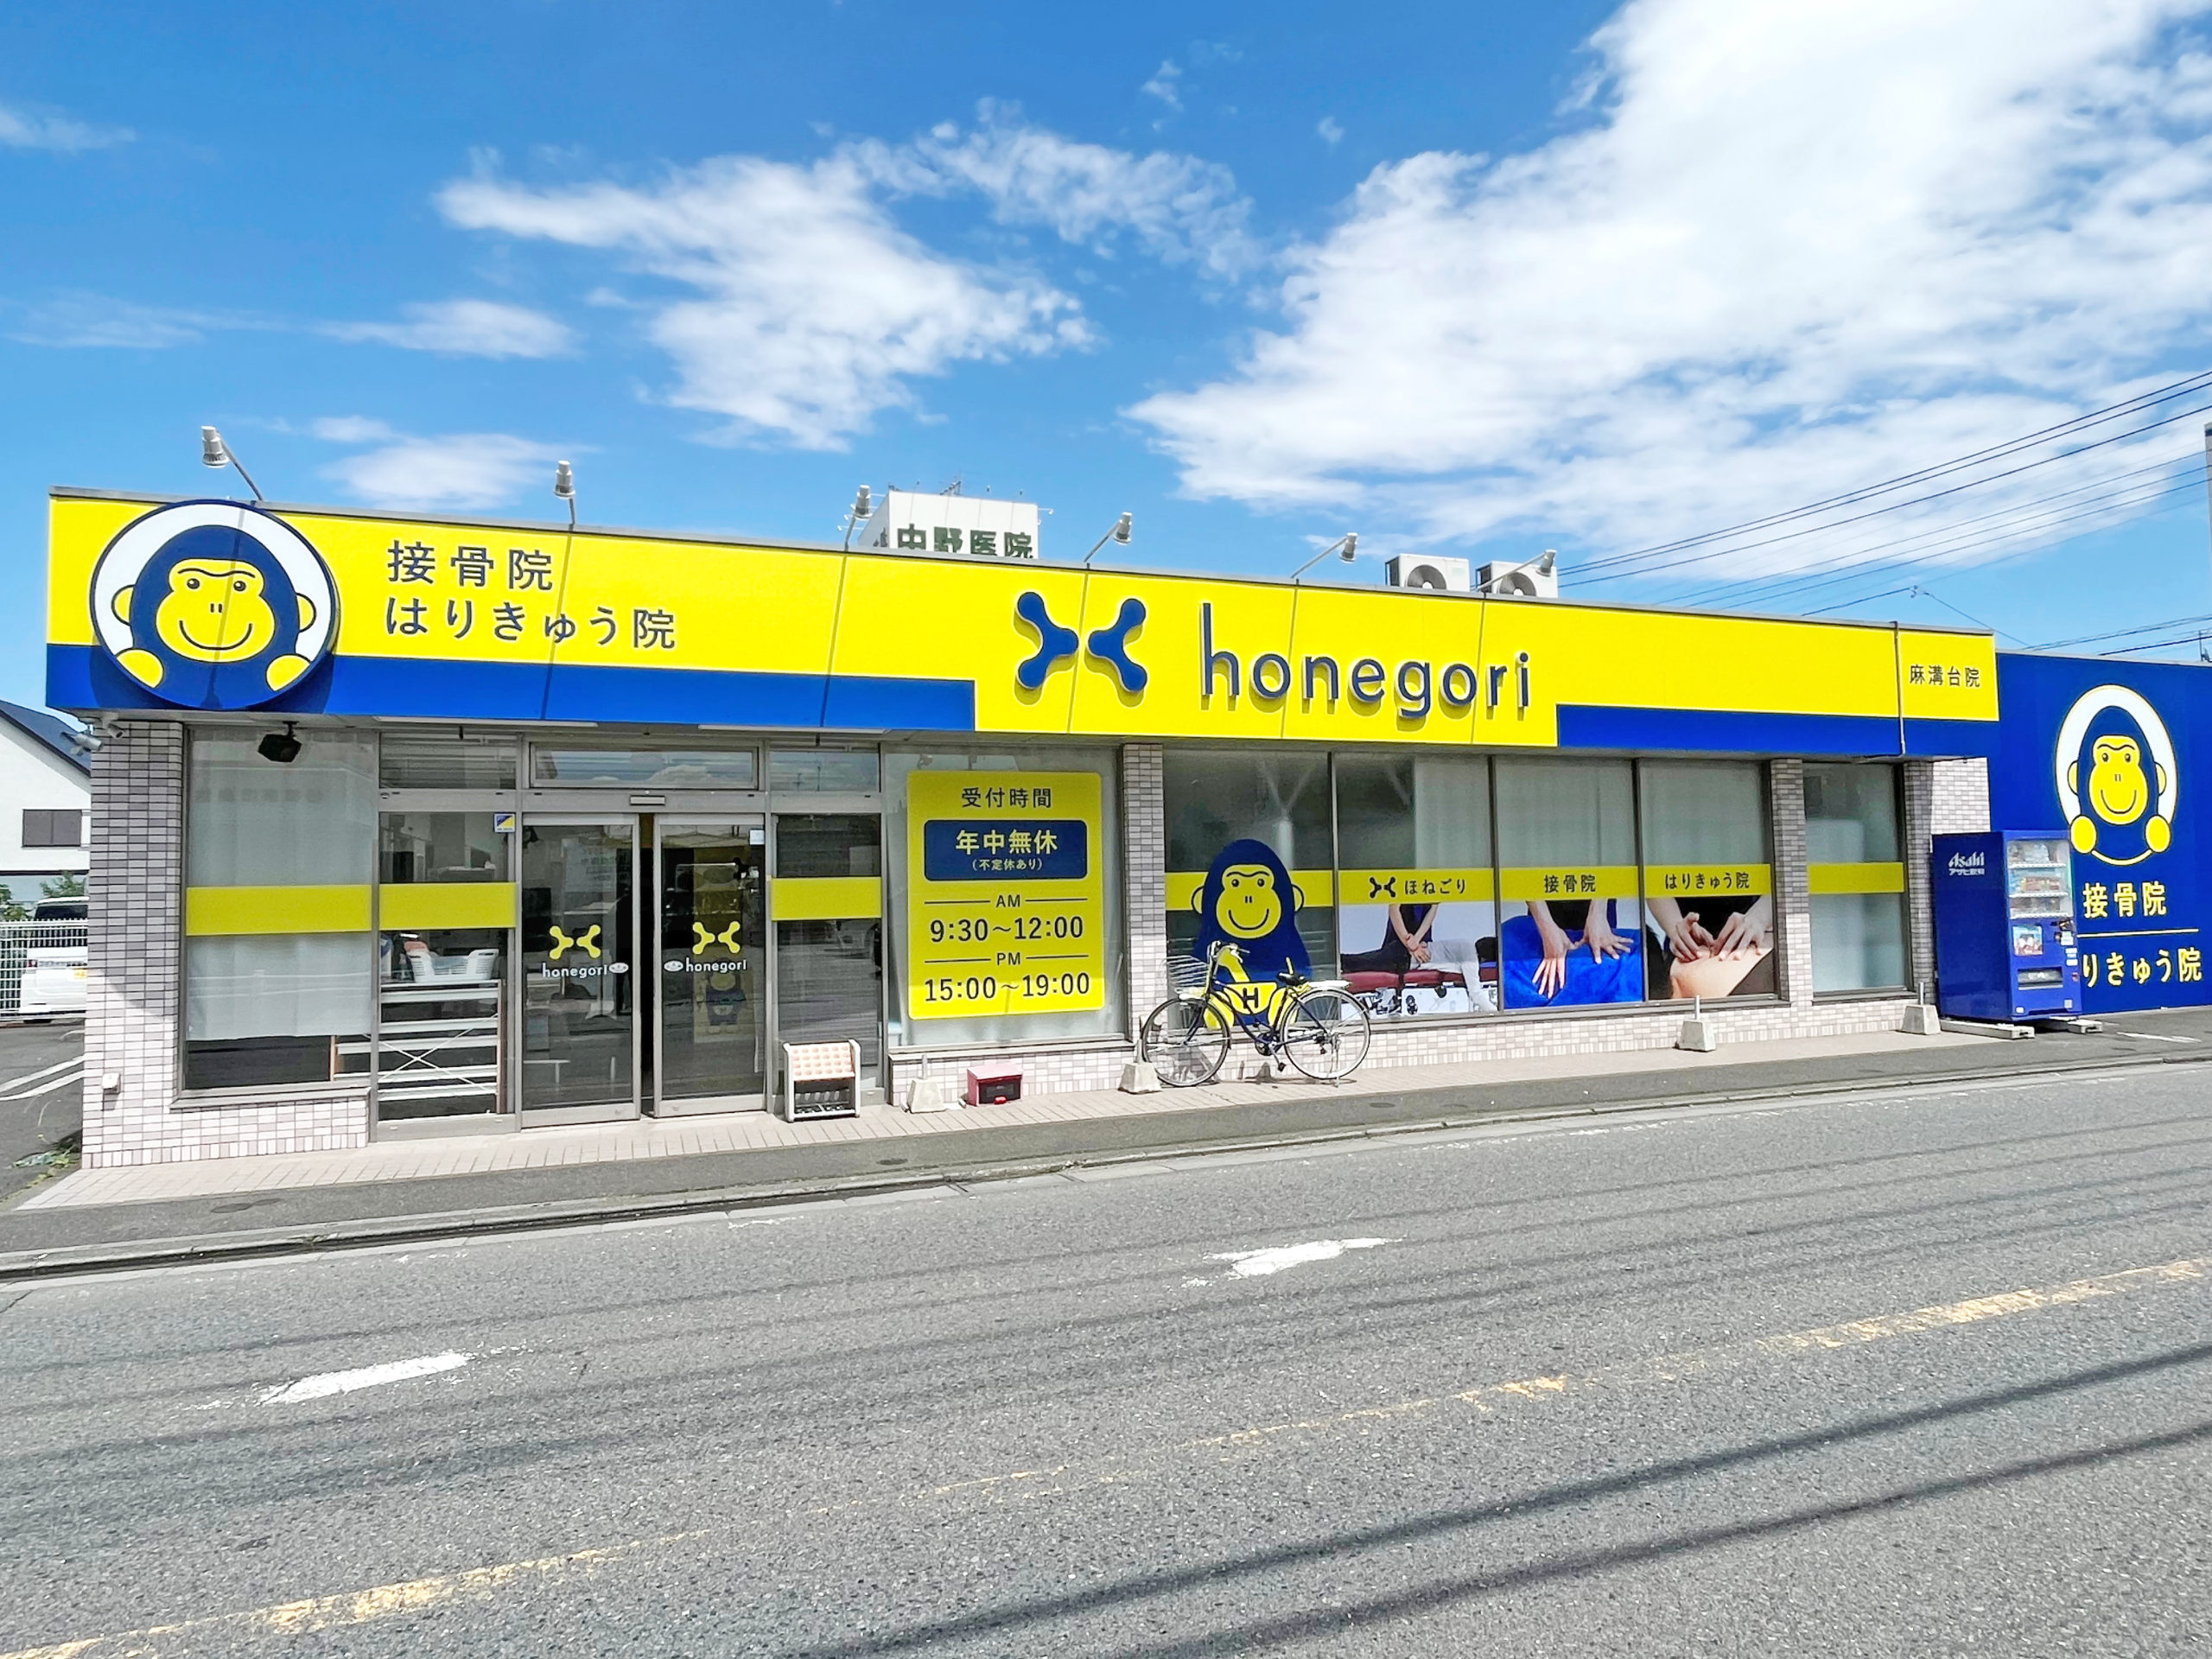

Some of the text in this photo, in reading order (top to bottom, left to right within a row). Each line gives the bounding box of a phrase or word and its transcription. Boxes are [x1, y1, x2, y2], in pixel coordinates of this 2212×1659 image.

[898, 524, 1033, 559] 中野医院
[387, 538, 554, 591] 接骨院
[387, 597, 676, 649] はりきゅう院
[1201, 602, 1531, 719] honegori
[1908, 664, 1981, 688] 麻溝台院
[961, 786, 1052, 809] 受付時間
[956, 830, 1058, 855] 年中無休
[1948, 851, 1985, 868] Asahi
[1404, 877, 1466, 895] ほねごり
[1543, 874, 1597, 893] 接骨院
[1664, 871, 1751, 890] はりきゅう院
[995, 894, 1021, 907] AM
[2082, 880, 2167, 918] 接骨院
[685, 957, 747, 973] honegori
[996, 952, 1021, 965] PM
[2082, 946, 2203, 988] りきゅう院
[543, 963, 607, 979] honegori
